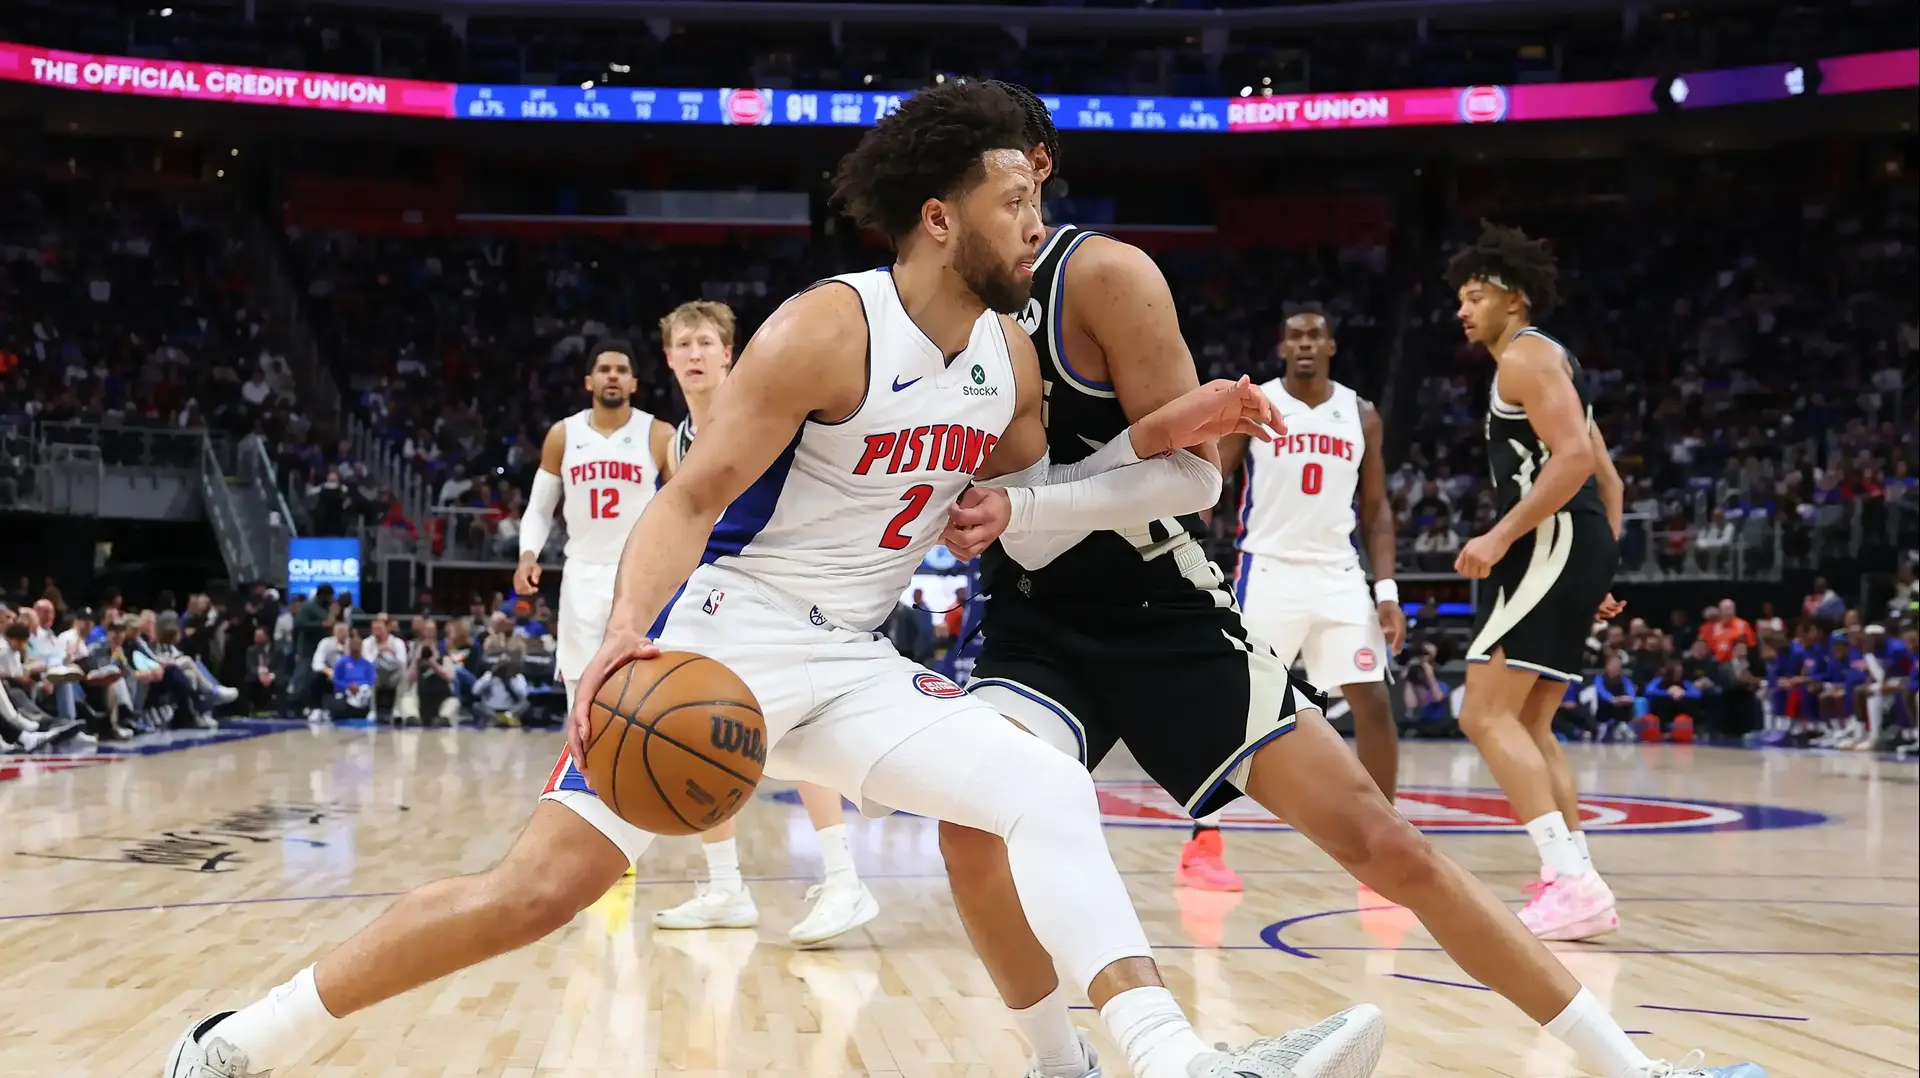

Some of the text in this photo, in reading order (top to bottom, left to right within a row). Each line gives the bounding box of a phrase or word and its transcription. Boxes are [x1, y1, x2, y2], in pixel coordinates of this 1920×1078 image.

[31, 57, 386, 105] THE OFFICIAL CREDIT UNION
[1303, 97, 1389, 120] UNION
[963, 386, 998, 396] StockX
[852, 424, 999, 476] PISTONS
[1272, 433, 1354, 462] PISTONS
[570, 461, 643, 486] PISTONS
[1301, 462, 1323, 495] 0
[590, 488, 620, 519] 12
[878, 484, 934, 550] 2
